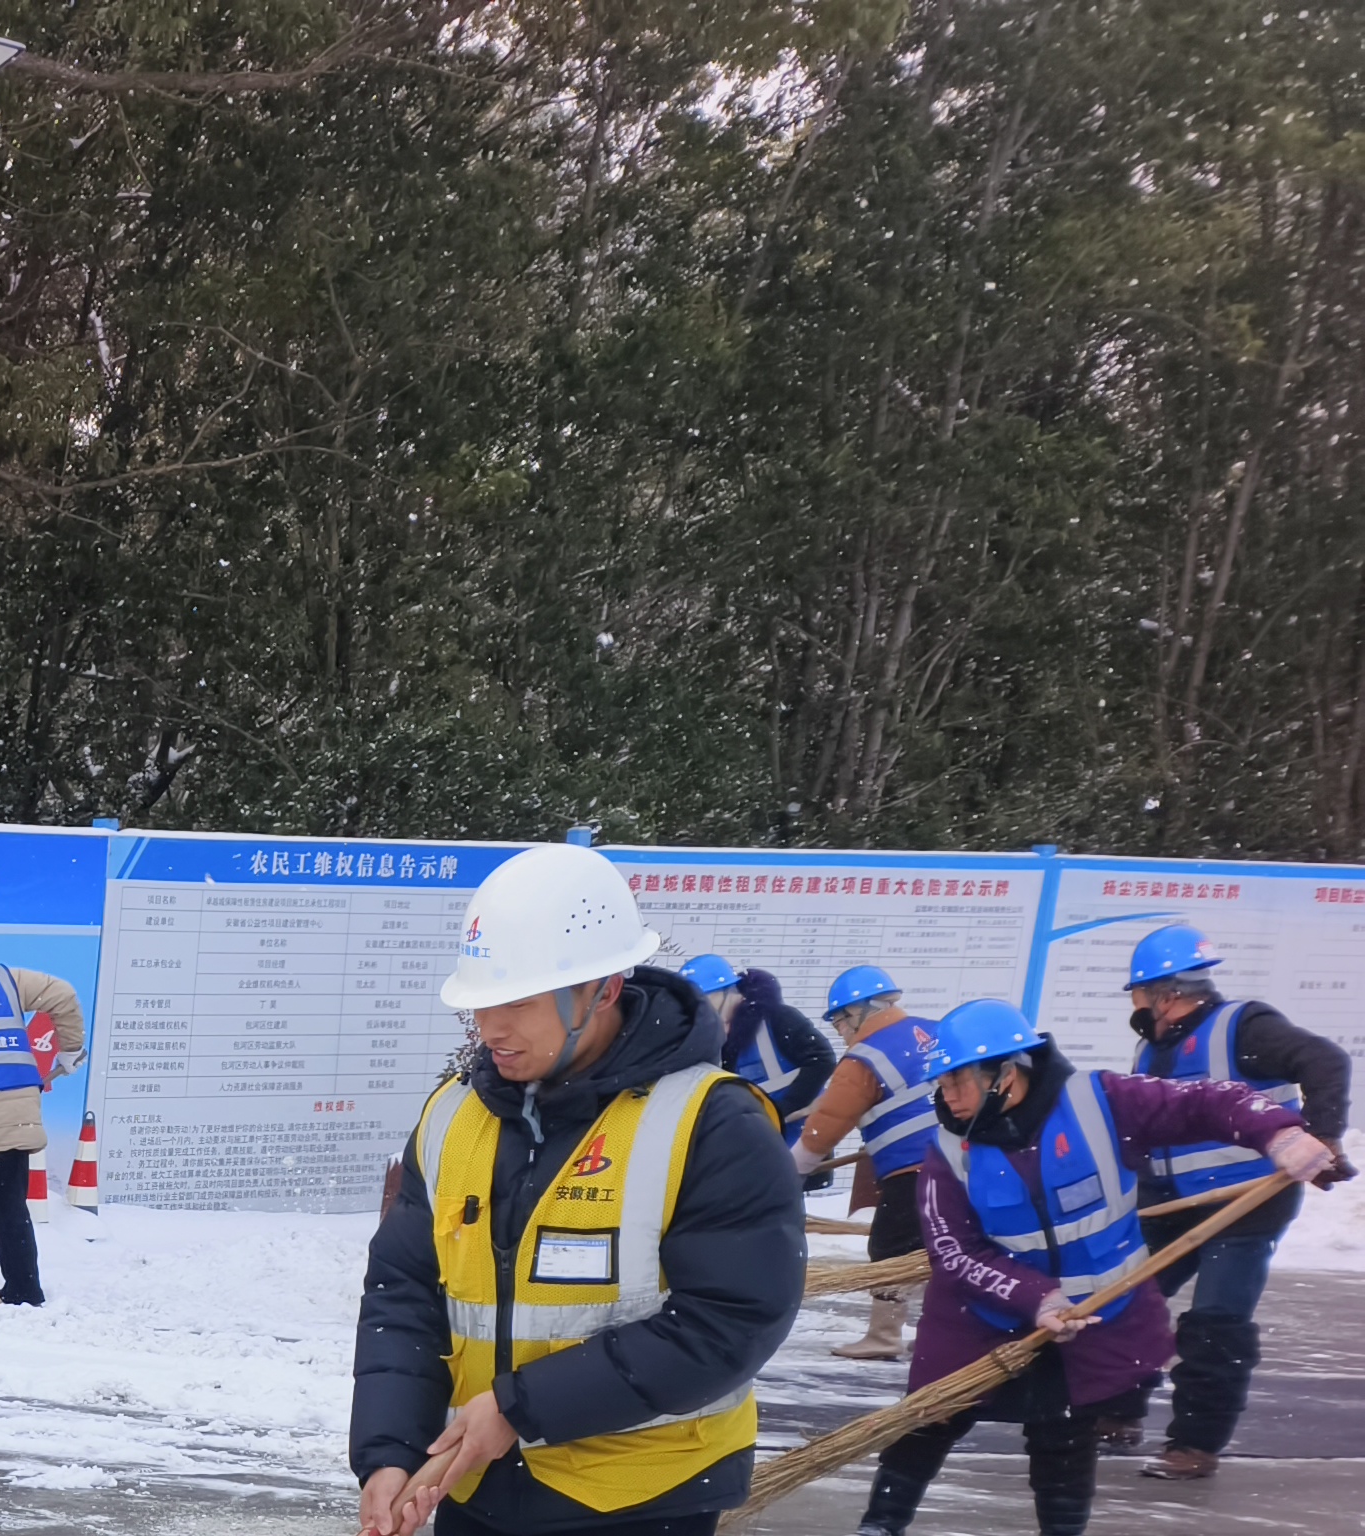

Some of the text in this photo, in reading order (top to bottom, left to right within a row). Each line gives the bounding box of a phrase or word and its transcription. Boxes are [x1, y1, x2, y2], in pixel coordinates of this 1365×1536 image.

[249, 850, 458, 880] 农民工维权信息告示牌
[628, 873, 1010, 897] 卓越城保障性租赁住房建设项目重大危险源公示牌
[1102, 880, 1241, 900] 扬尘污染防治公示牌
[145, 916, 175, 926] 建设单位
[131, 959, 182, 969] 施工总承包企业
[555, 1185, 617, 1203] 安徽建工
